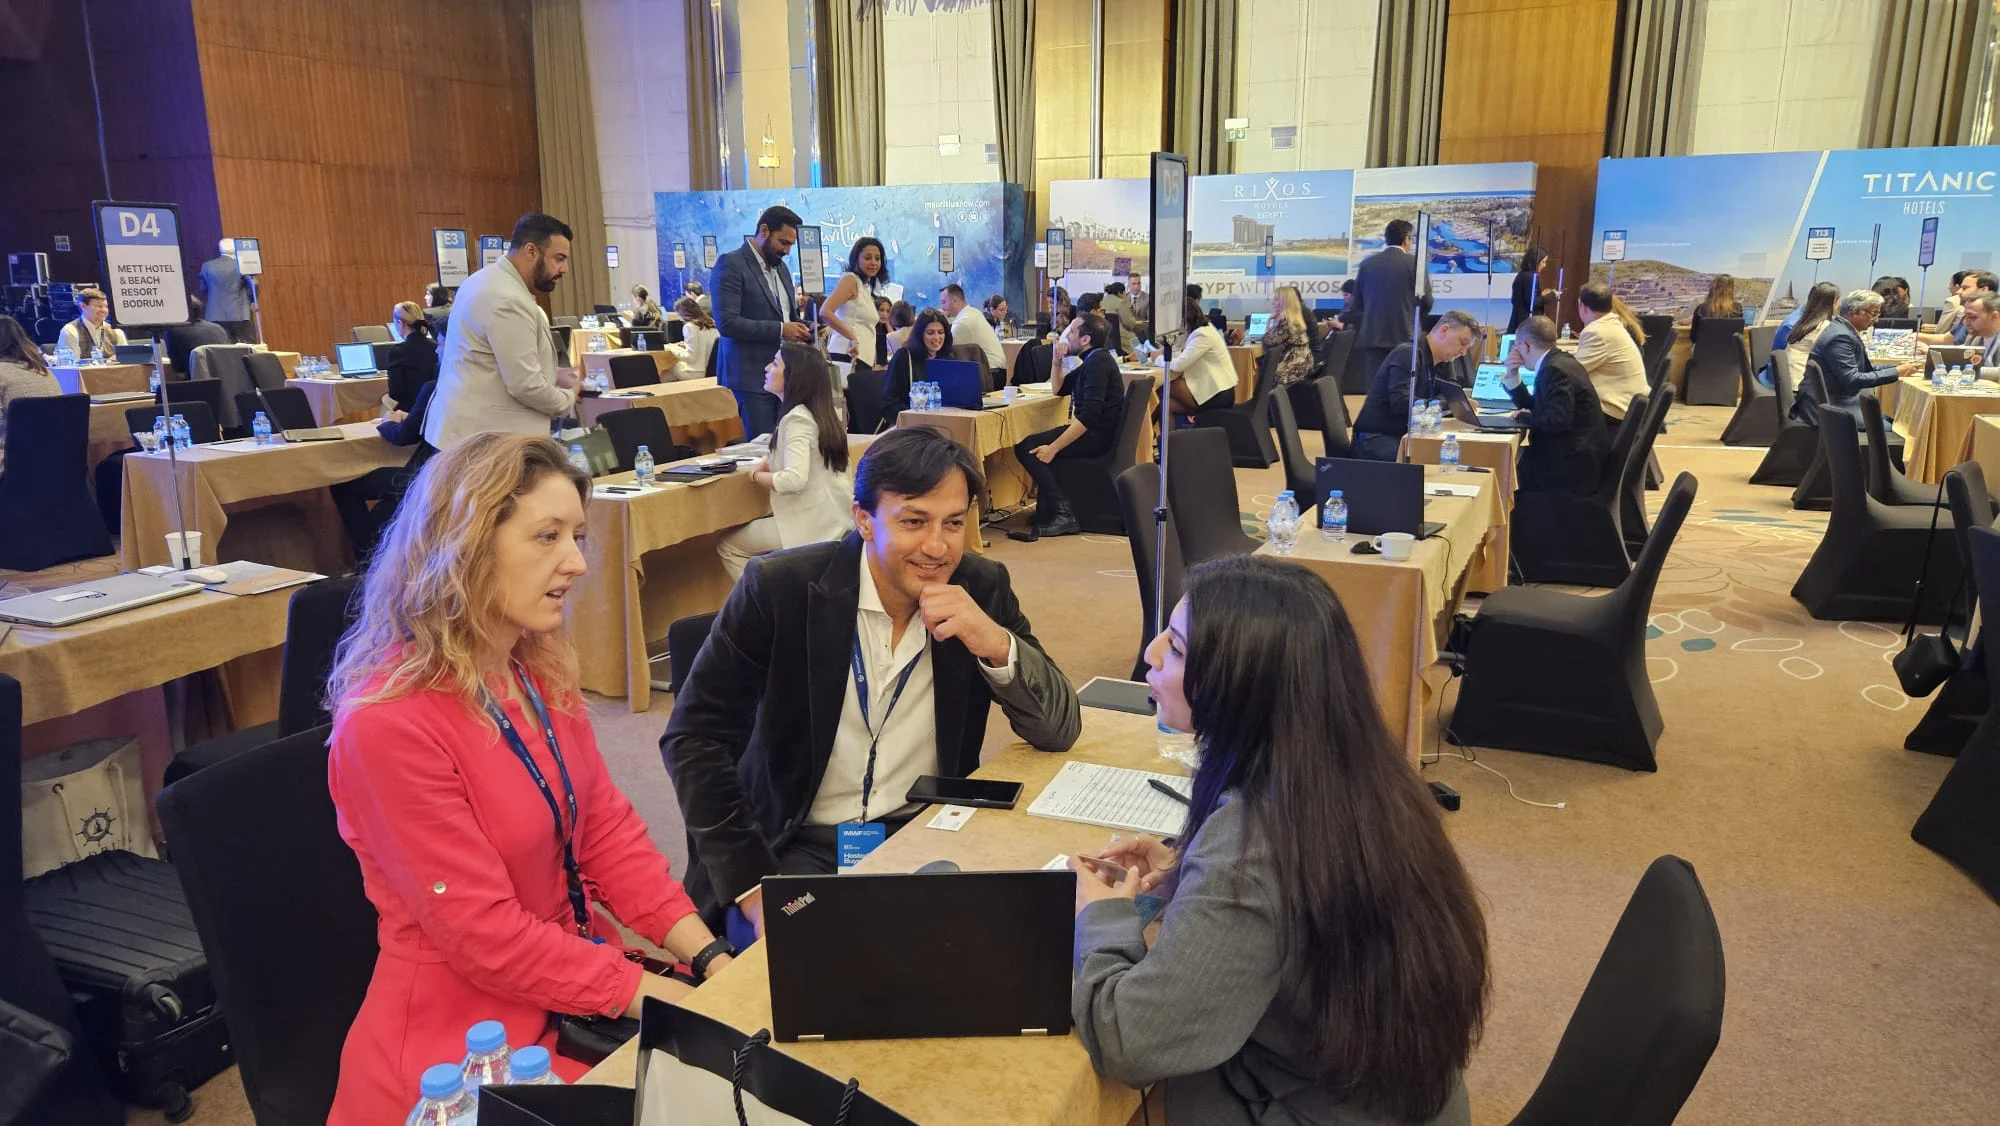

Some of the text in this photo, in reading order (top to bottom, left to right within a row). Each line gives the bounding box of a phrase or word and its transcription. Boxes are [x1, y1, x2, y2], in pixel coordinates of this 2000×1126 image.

[1163, 168, 1179, 207] D5
[1863, 170, 1997, 193] TITANIC
[1234, 177, 1311, 201] RIXOS
[924, 199, 990, 209] mauritiusnow.com
[1903, 200, 1946, 216] HOTELS
[119, 211, 161, 238] D4
[443, 232, 458, 245] E3
[487, 238, 498, 248] F2
[803, 230, 815, 245] E4
[242, 240, 252, 249] F1
[117, 264, 175, 273] METT HOTEL
[119, 276, 161, 285] & BEACH
[121, 287, 158, 297] RESORT
[1197, 282, 1236, 296] YPT
[123, 299, 164, 309] BODRUM
[781, 891, 816, 916] ThinkPad
